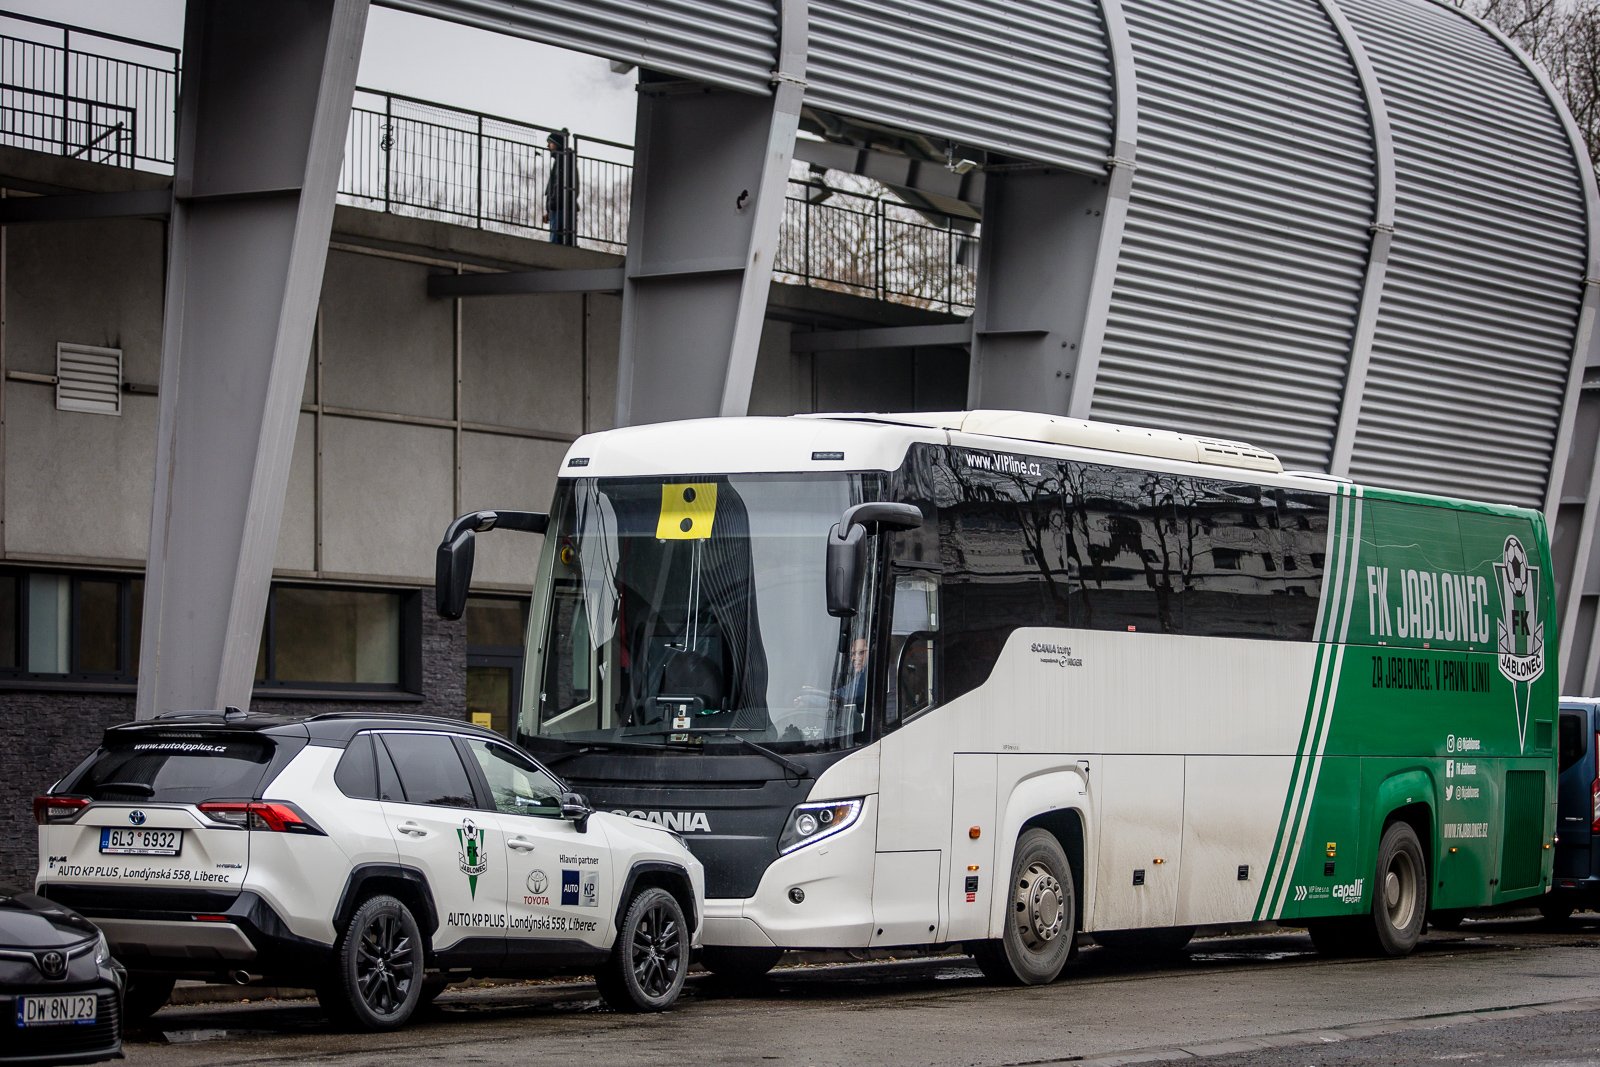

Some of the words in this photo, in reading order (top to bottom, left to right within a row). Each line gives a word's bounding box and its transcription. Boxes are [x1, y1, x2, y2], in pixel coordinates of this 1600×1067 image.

[966, 453, 1041, 476] www.VIPline.cz
[1367, 565, 1392, 636] FK
[1397, 568, 1489, 643] JABLONEC
[1512, 610, 1530, 636] FK
[1372, 656, 1382, 688] ZA
[1386, 656, 1432, 690] JABLONEC.
[1435, 660, 1440, 690] V
[1443, 654, 1468, 692] PRVNÍ
[1471, 662, 1489, 692] LINII
[1501, 653, 1541, 677] JABLONEC
[134, 742, 227, 752] www.autokpplus.cz
[112, 831, 135, 847] 6L3
[143, 832, 175, 848] 6932
[467, 846, 479, 857] FK
[560, 855, 577, 864] Hlavní
[578, 856, 599, 866] partner
[58, 865, 81, 876] AUTO
[82, 866, 94, 876] KP
[124, 867, 171, 880] Londýnská
[172, 869, 192, 882] 558,
[194, 870, 229, 882] Liberec
[461, 864, 485, 873] JABLONEC
[563, 884, 579, 893] AUTO
[584, 883, 594, 895] KP
[1333, 879, 1362, 901] capelli
[524, 896, 549, 905] TOYOTA
[447, 912, 470, 926] AUTO
[472, 913, 482, 926] KP
[510, 915, 550, 932] Londýnská
[551, 916, 567, 932] 558,
[569, 918, 596, 931] Liberec
[28, 1000, 46, 1020] DW
[51, 998, 93, 1019] 8NJ23
